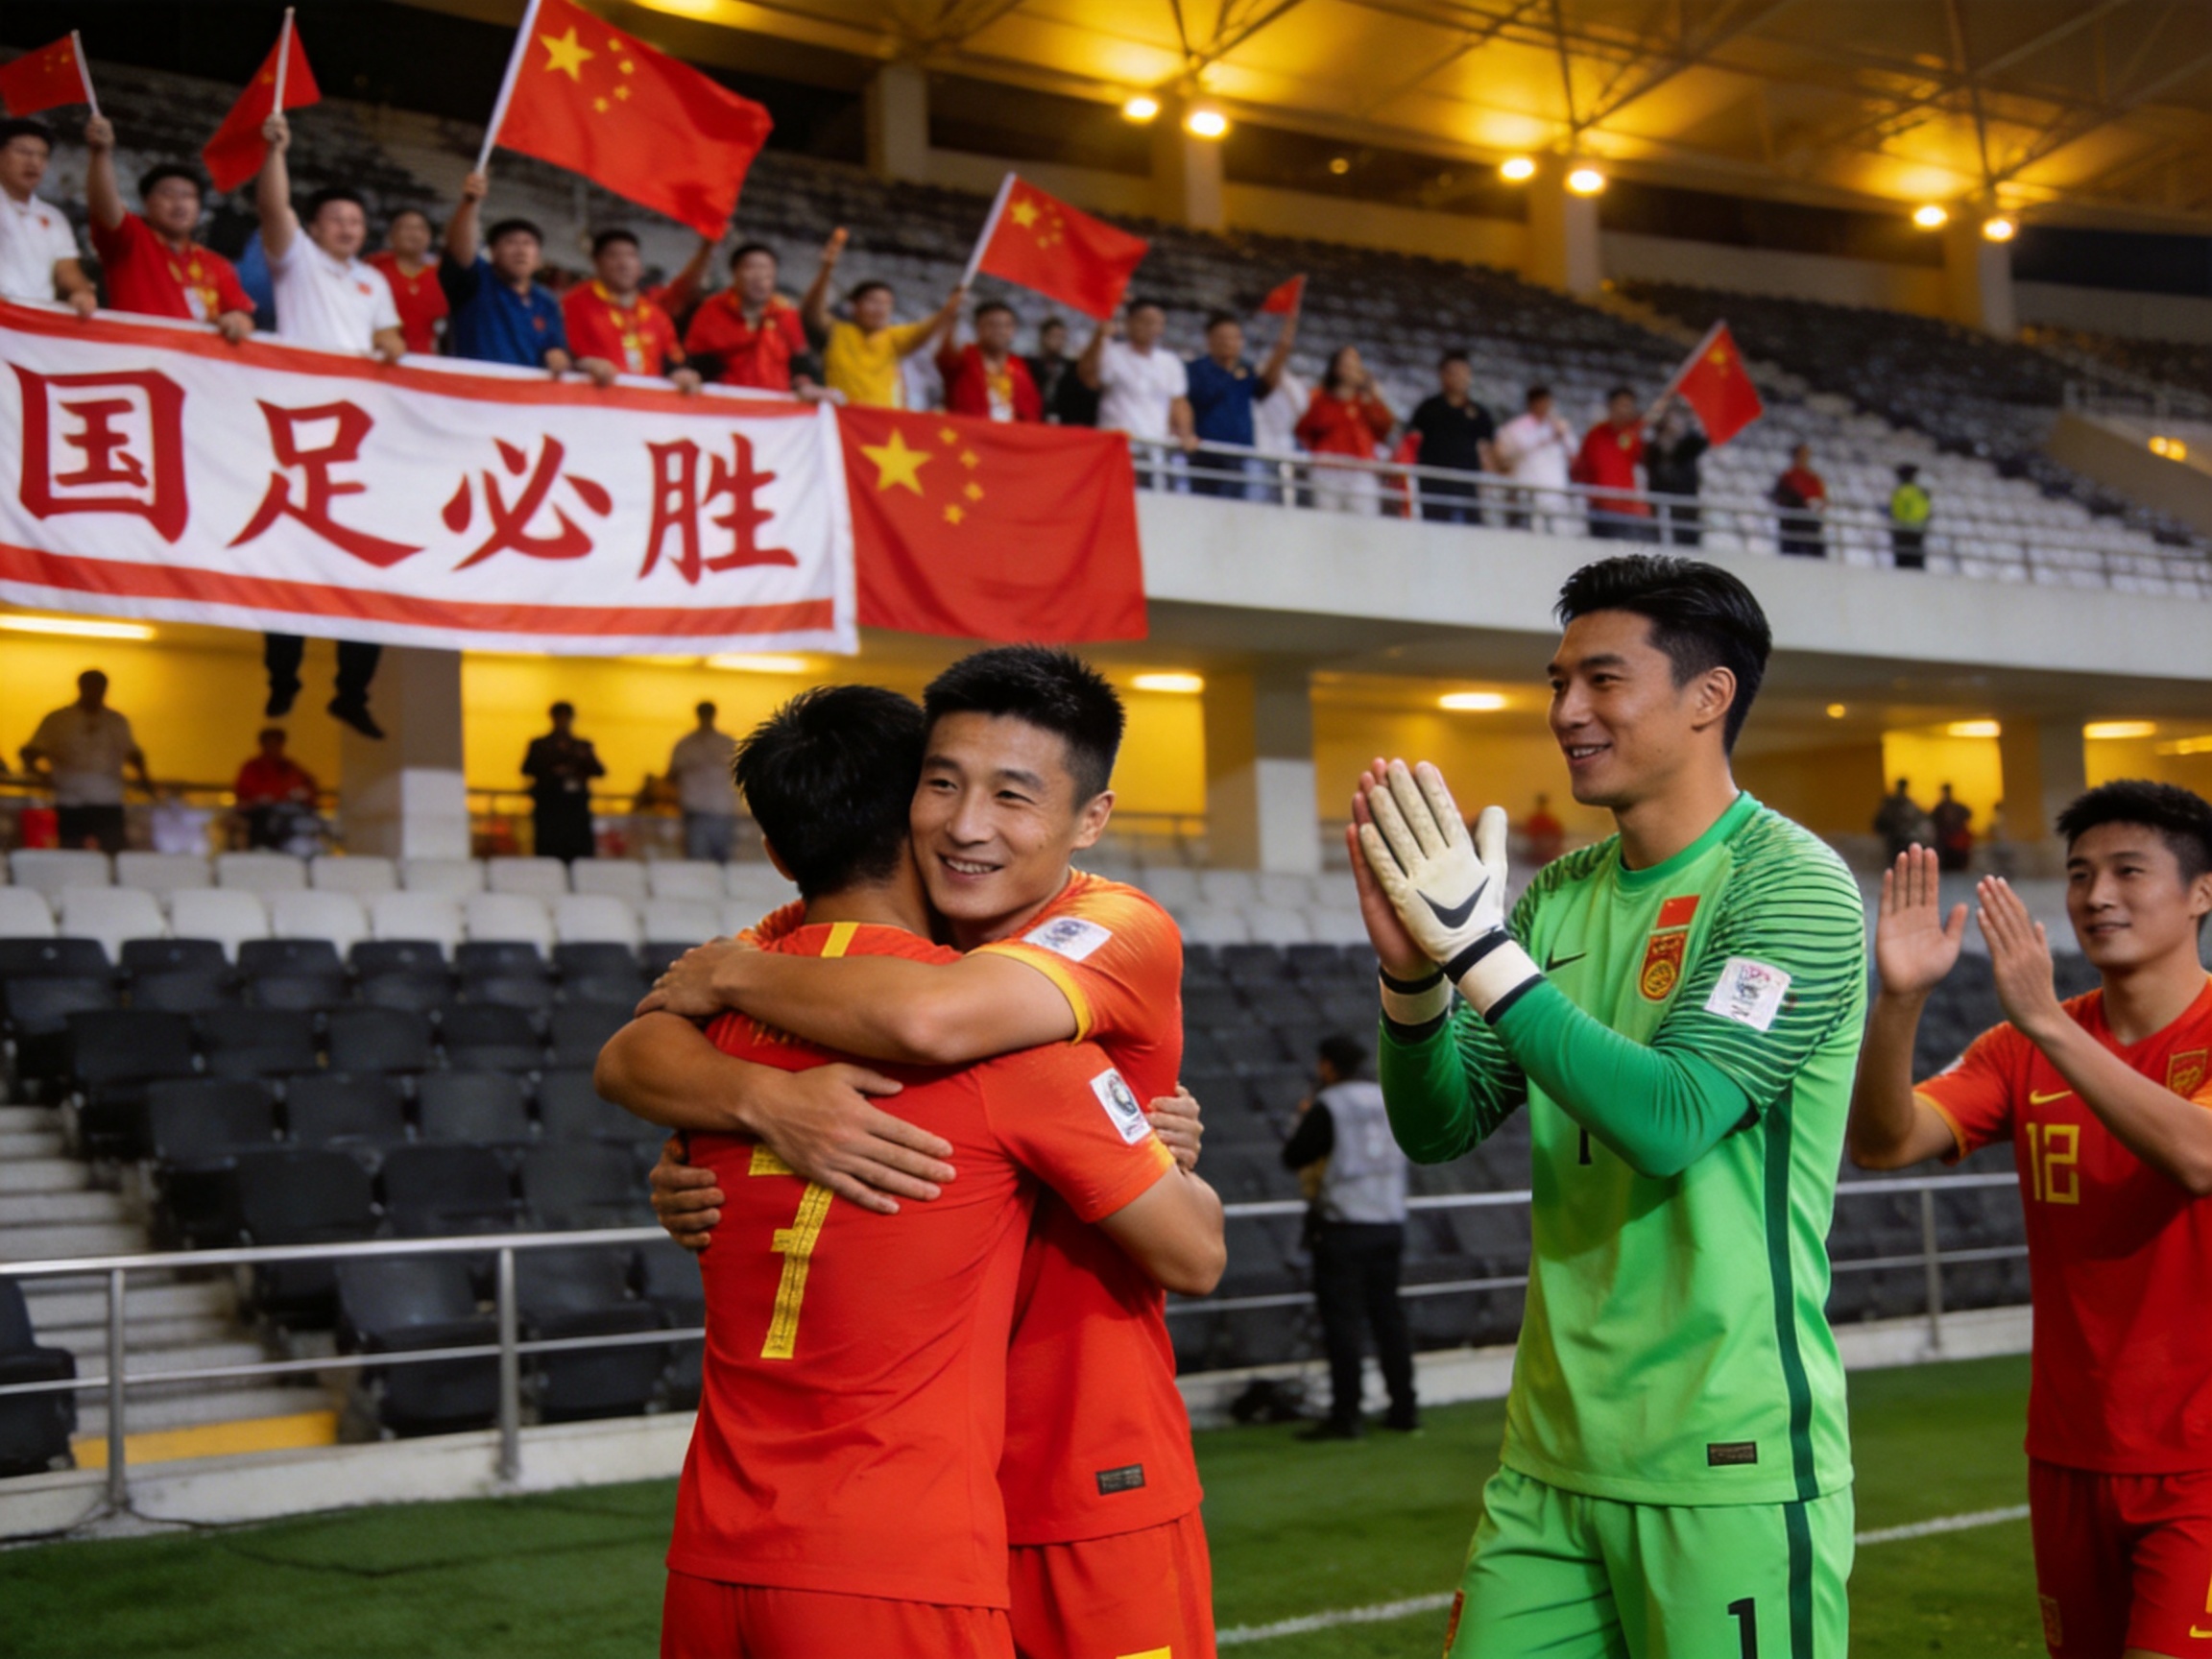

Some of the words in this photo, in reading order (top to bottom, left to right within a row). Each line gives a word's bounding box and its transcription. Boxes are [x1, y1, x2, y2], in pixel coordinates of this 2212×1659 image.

[8, 362, 800, 586] 国足必胜
[2025, 1122, 2080, 1205] 12
[748, 1142, 834, 1359] 7
[1727, 1597, 1759, 1659] 1
